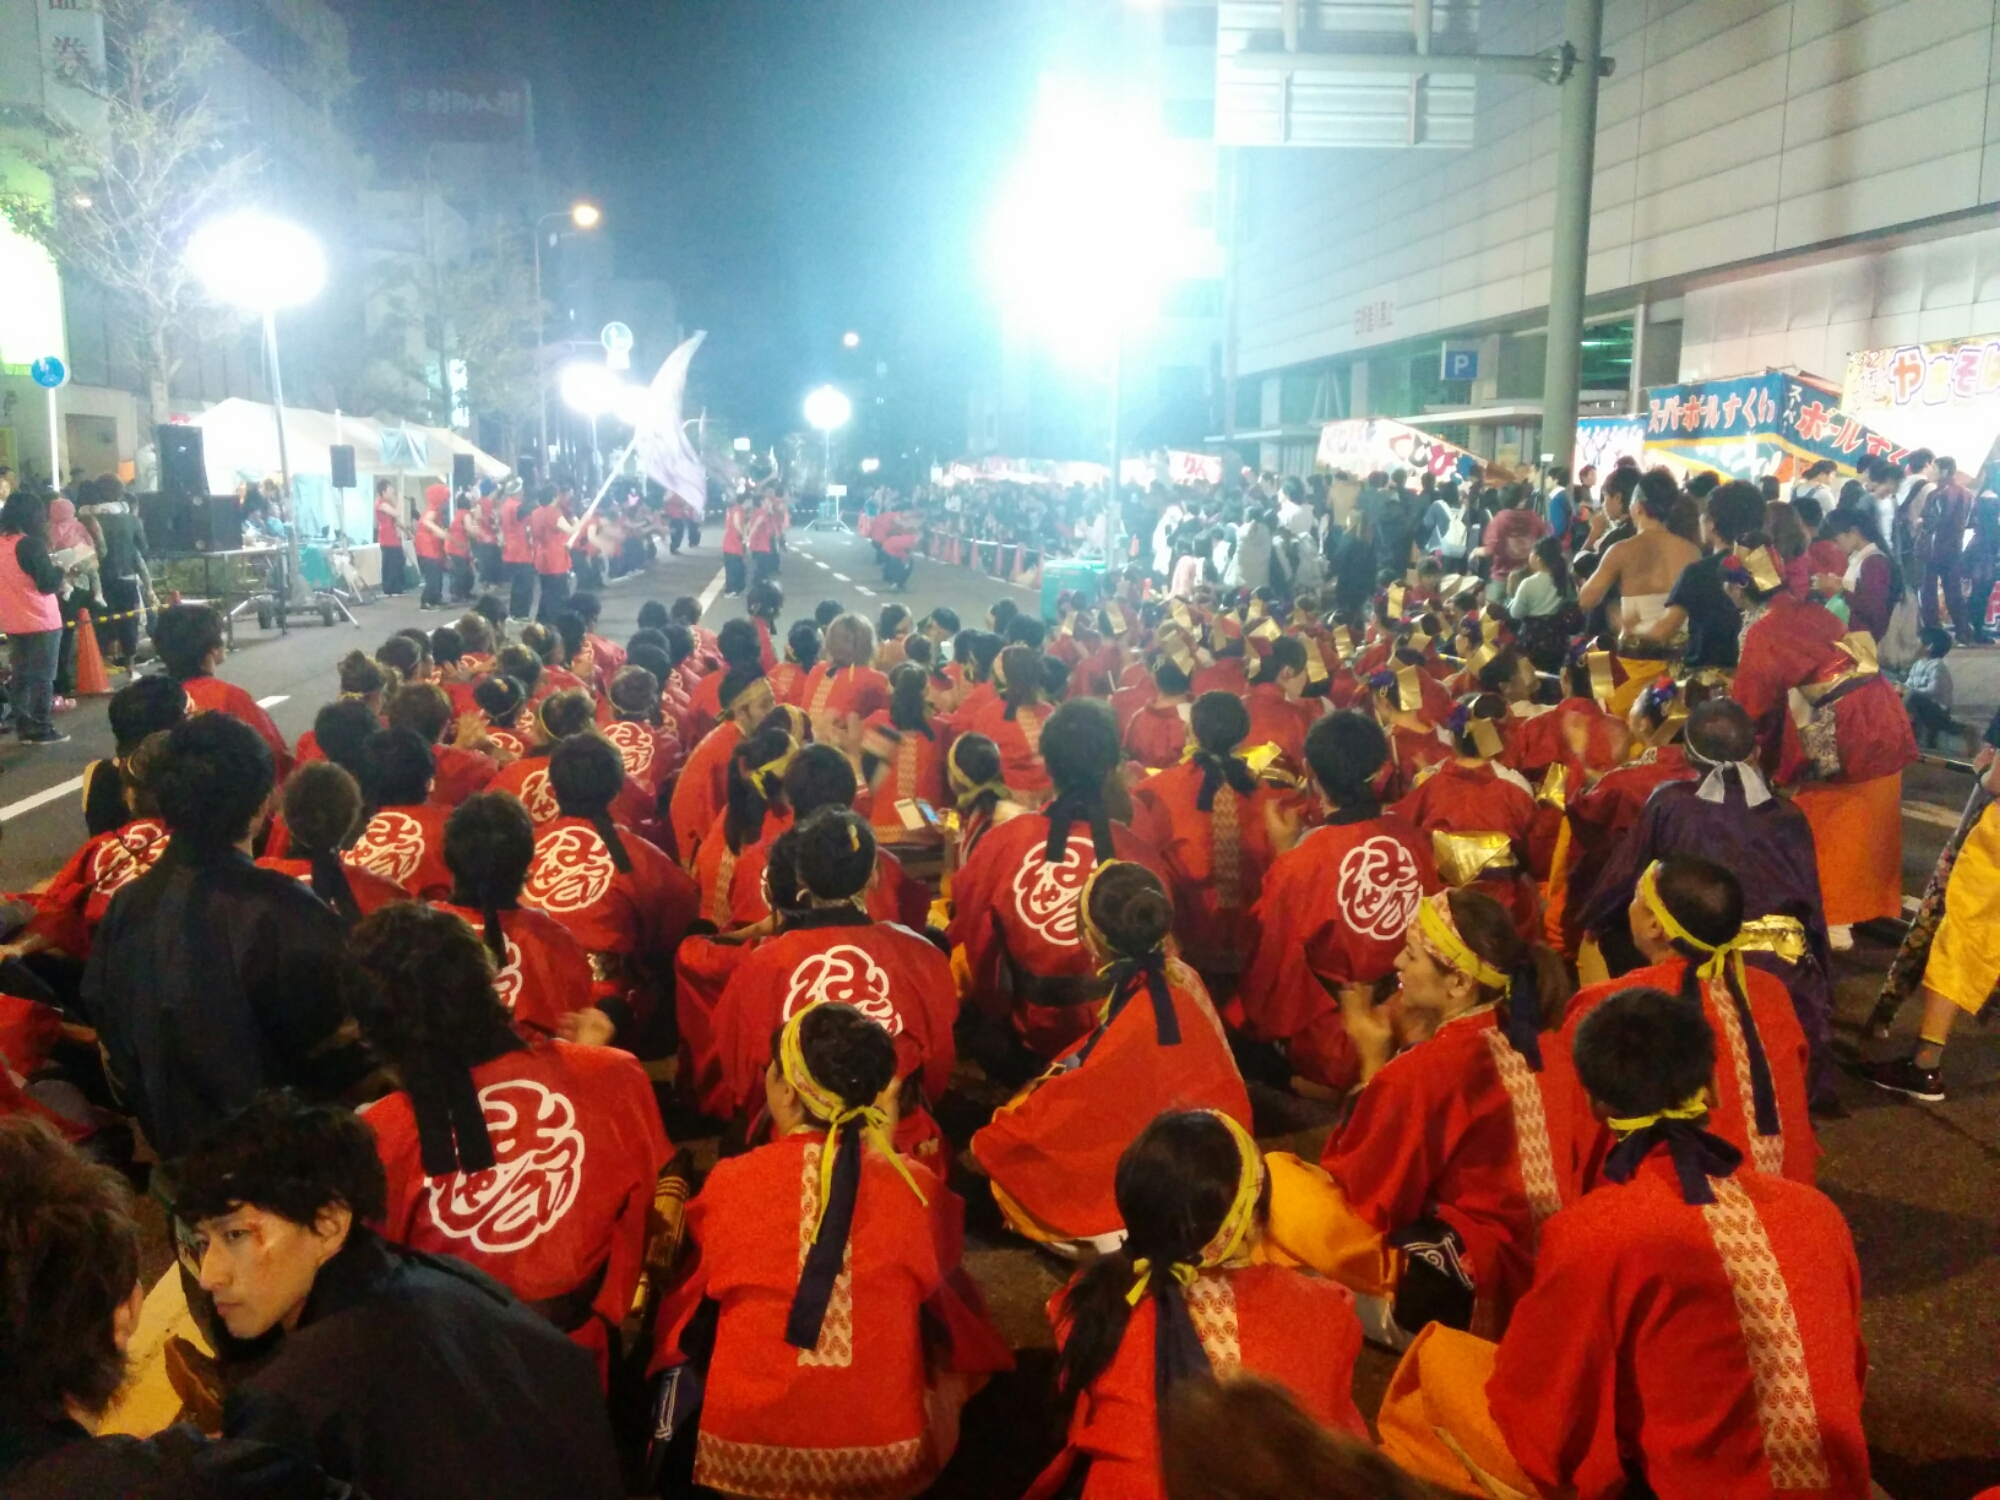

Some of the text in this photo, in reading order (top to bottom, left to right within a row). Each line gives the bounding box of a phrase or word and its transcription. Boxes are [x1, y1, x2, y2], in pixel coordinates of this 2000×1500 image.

[1454, 354, 1469, 375] P
[1648, 387, 1776, 433] スーパーボールすくい
[1794, 400, 1912, 476] ボールすく
